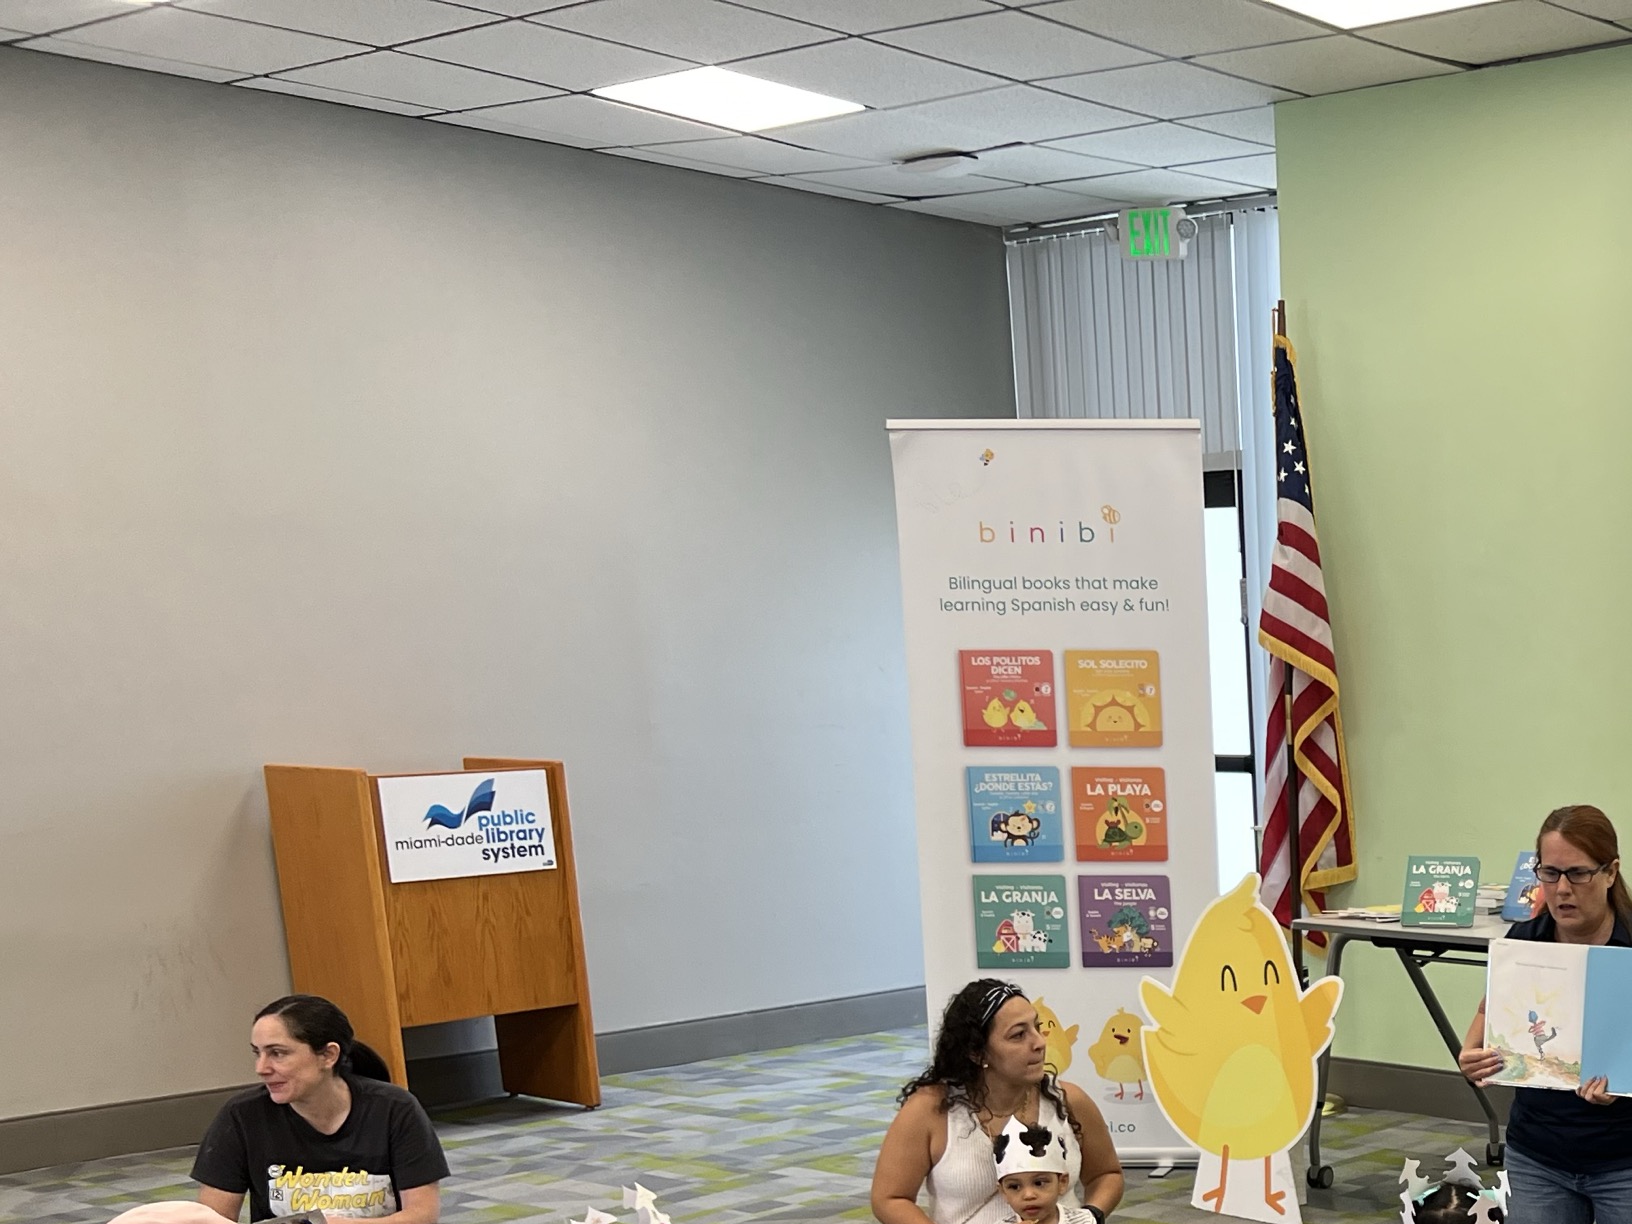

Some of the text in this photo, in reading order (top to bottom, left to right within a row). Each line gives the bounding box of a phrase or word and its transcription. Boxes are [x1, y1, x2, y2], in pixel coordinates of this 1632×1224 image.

[1128, 209, 1171, 257] EXIT
[978, 519, 1116, 544] binibi
[948, 575, 1159, 594] Bilingual books that make
[939, 598, 1170, 616] learning Spanish easy & fun!
[971, 656, 1041, 666] LOS POLLITOS
[1078, 659, 1148, 669] SOL SOLECITO
[991, 666, 1022, 675] DICEN
[984, 773, 1042, 782] ESTRELLITA
[1086, 784, 1152, 796] LA PLAYA
[477, 809, 536, 831] public
[395, 827, 545, 851] miami-dade library
[482, 843, 545, 863] system
[1412, 865, 1426, 875] LA
[1429, 865, 1472, 877] GRANJA
[981, 890, 1059, 905] LA GRANJA
[1094, 888, 1156, 900] LA SELVA
[276, 1165, 370, 1189] Wonder
[290, 1187, 387, 1212] Woman
